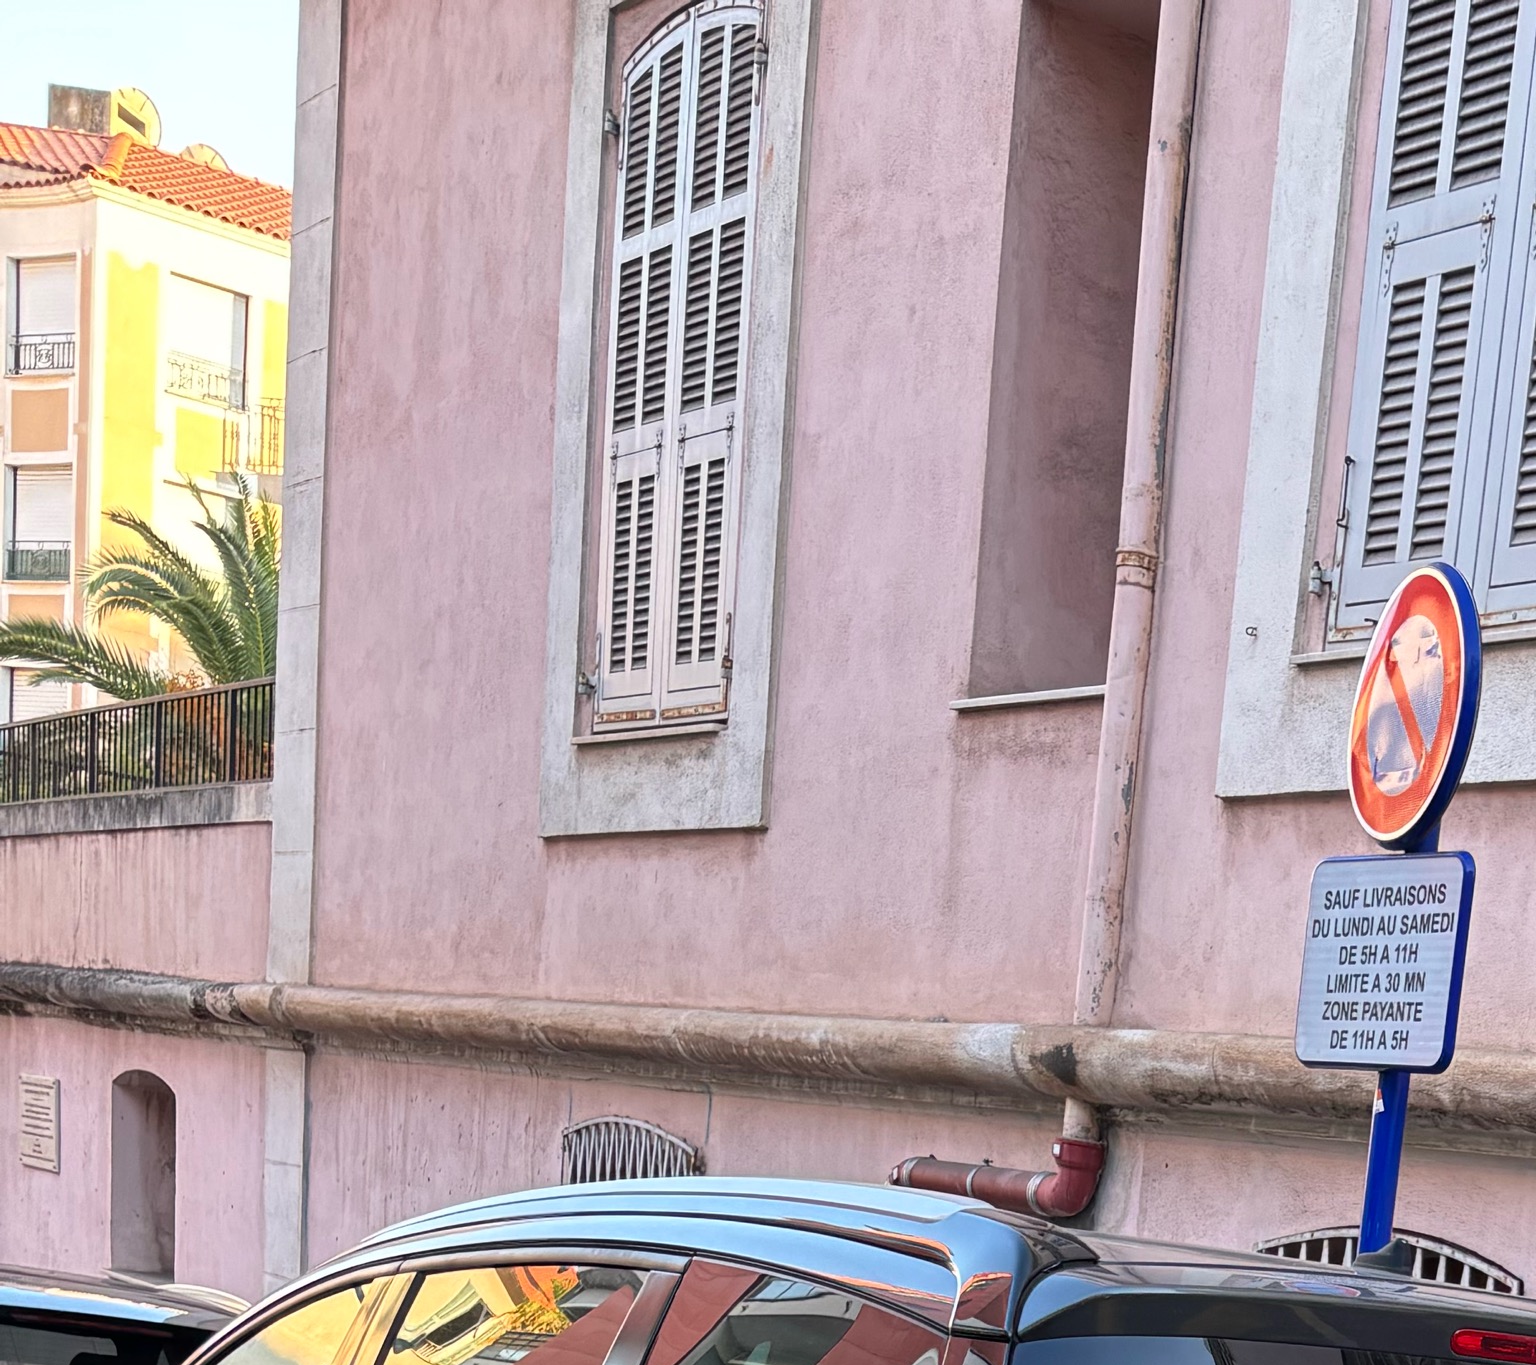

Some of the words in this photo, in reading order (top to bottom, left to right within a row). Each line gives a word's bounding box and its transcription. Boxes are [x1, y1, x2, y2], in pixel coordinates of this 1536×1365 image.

[1324, 889, 1360, 910] SAUF
[1363, 884, 1447, 908] LIVRAISONS
[1312, 919, 1331, 938] DU
[1334, 916, 1374, 937] LUNDI
[1376, 915, 1397, 936] AU
[1400, 913, 1455, 934] SAMEDI
[1339, 946, 1357, 965] DE
[1361, 945, 1378, 964] 5H
[1380, 945, 1389, 964] A
[1395, 943, 1419, 963] 11H
[1326, 974, 1369, 993] LIMITE
[1371, 973, 1381, 992] A
[1385, 973, 1400, 992] 30
[1404, 972, 1426, 992] MN
[1322, 1002, 1359, 1021] ZONE
[1362, 1002, 1423, 1022] PAYANTE
[1330, 1030, 1348, 1049] DE
[1352, 1030, 1376, 1049] 11H
[1377, 1031, 1387, 1050] A
[1391, 1031, 1409, 1050] 5H
